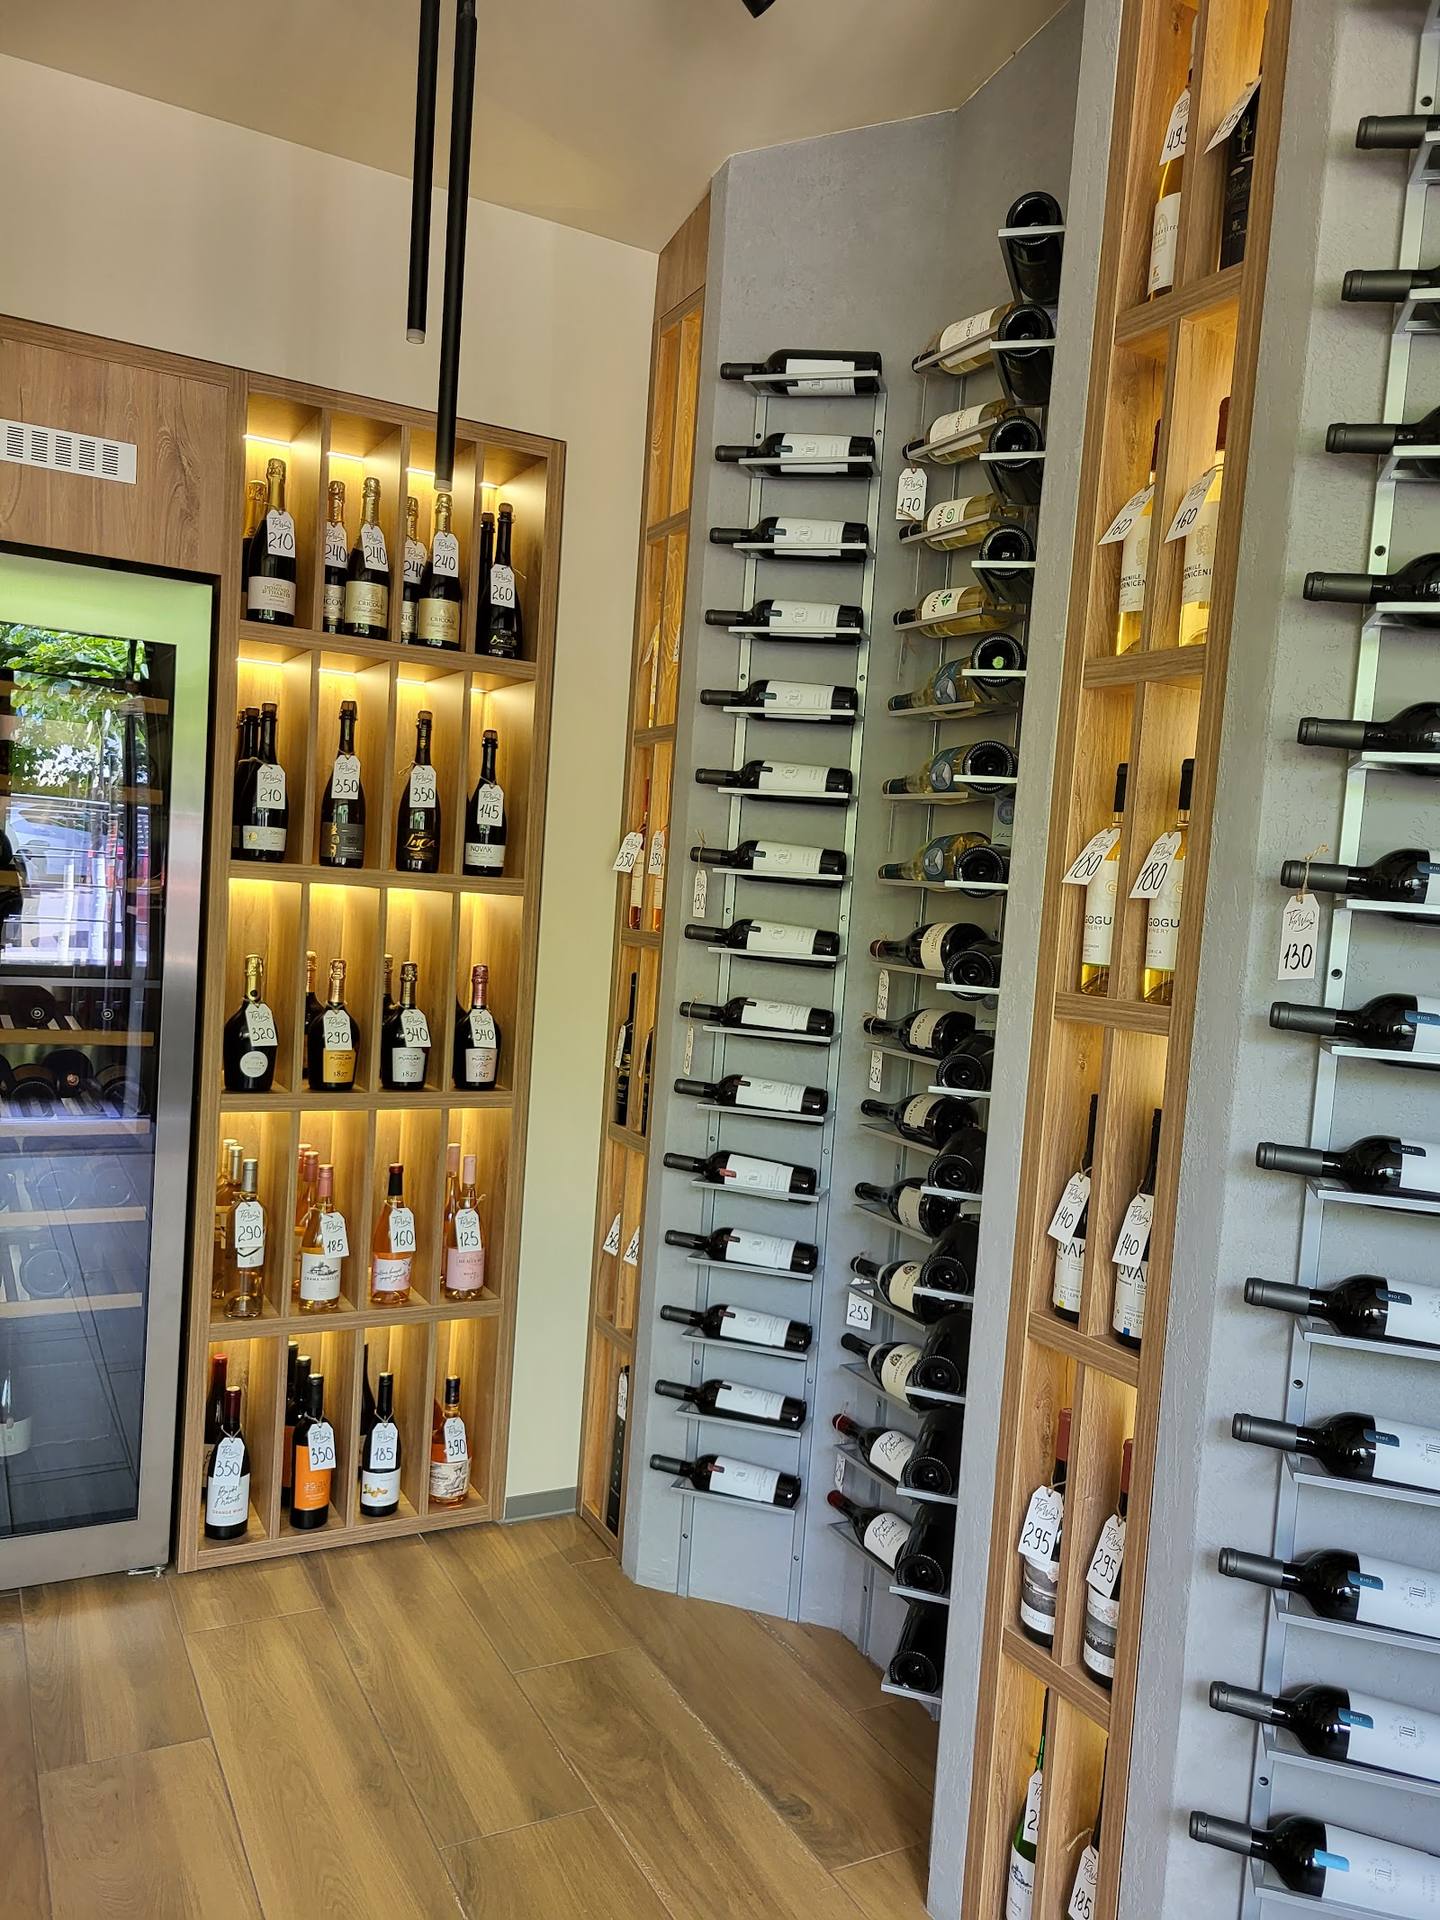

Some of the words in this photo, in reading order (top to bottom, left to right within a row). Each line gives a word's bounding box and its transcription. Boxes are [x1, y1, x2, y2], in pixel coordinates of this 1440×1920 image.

[900, 497, 921, 512] 170
[1107, 518, 1133, 538] 160
[1174, 507, 1198, 534] 160
[268, 532, 294, 551] 210
[325, 543, 347, 563] 240
[365, 545, 387, 566] 240
[434, 554, 456, 571] 240
[492, 584, 513, 601] 260
[260, 787, 282, 802] 210
[334, 778, 359, 794] 350
[412, 787, 435, 803] 350
[479, 803, 500, 820] 145
[470, 845, 493, 853] NOVAK
[616, 852, 635, 868] 350
[1070, 852, 1102, 879] 180
[1137, 862, 1168, 892] 180
[1283, 943, 1313, 970] 130
[251, 1027, 275, 1042] 320
[326, 1031, 350, 1045] 290
[405, 1027, 429, 1043] 340
[474, 1028, 495, 1042] 340
[1055, 1205, 1074, 1229] 140
[238, 1225, 262, 1242] 290
[394, 1230, 414, 1248] 160
[460, 1231, 479, 1248] 125
[326, 1239, 344, 1254] 185
[1119, 1232, 1140, 1257] 140
[849, 1303, 869, 1322] 255
[311, 1446, 333, 1465] 350
[373, 1447, 394, 1461] 185
[448, 1439, 467, 1456] 390
[215, 1460, 240, 1477] 350
[1023, 1521, 1052, 1555] 295
[1093, 1549, 1117, 1584] 295
[1074, 1887, 1092, 1919] 185
